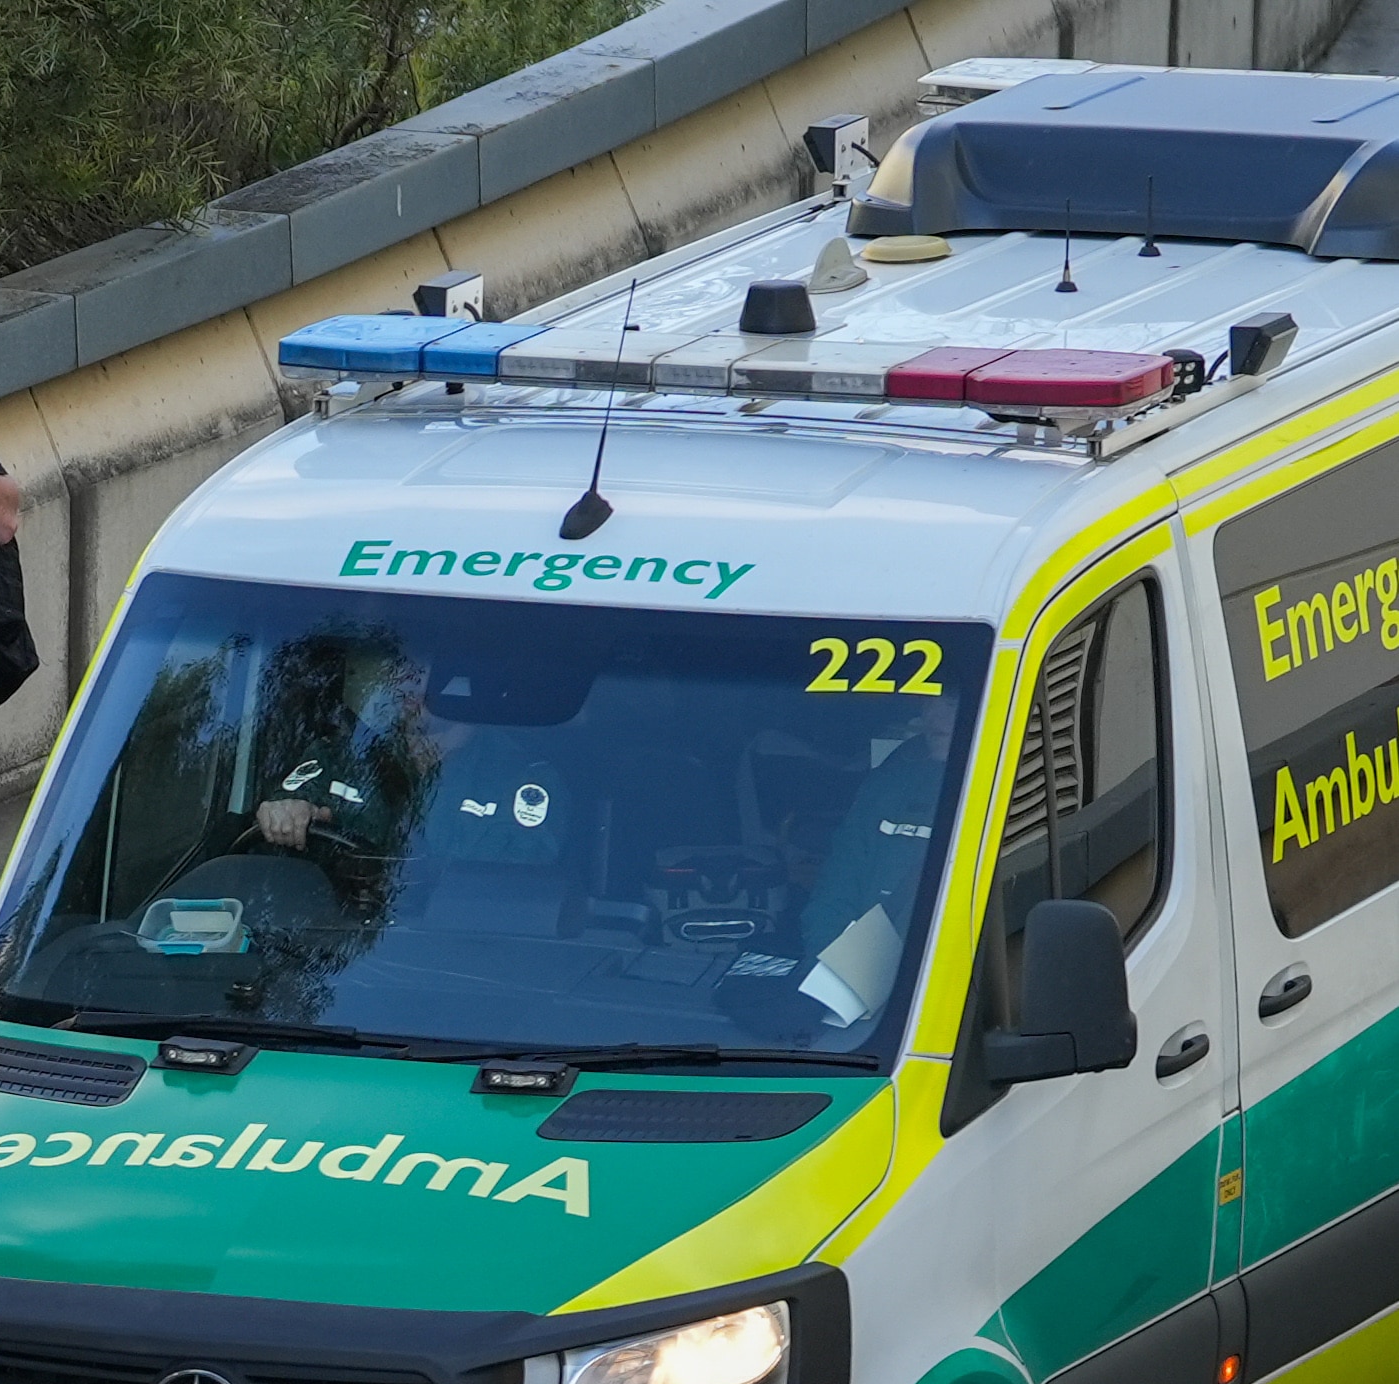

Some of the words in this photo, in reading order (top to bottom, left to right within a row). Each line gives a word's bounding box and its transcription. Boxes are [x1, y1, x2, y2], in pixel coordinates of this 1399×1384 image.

[338, 539, 757, 600] Emergency
[804, 636, 945, 696] 222
[1253, 556, 1399, 683] Emerg
[1271, 708, 1399, 865] Ambu
